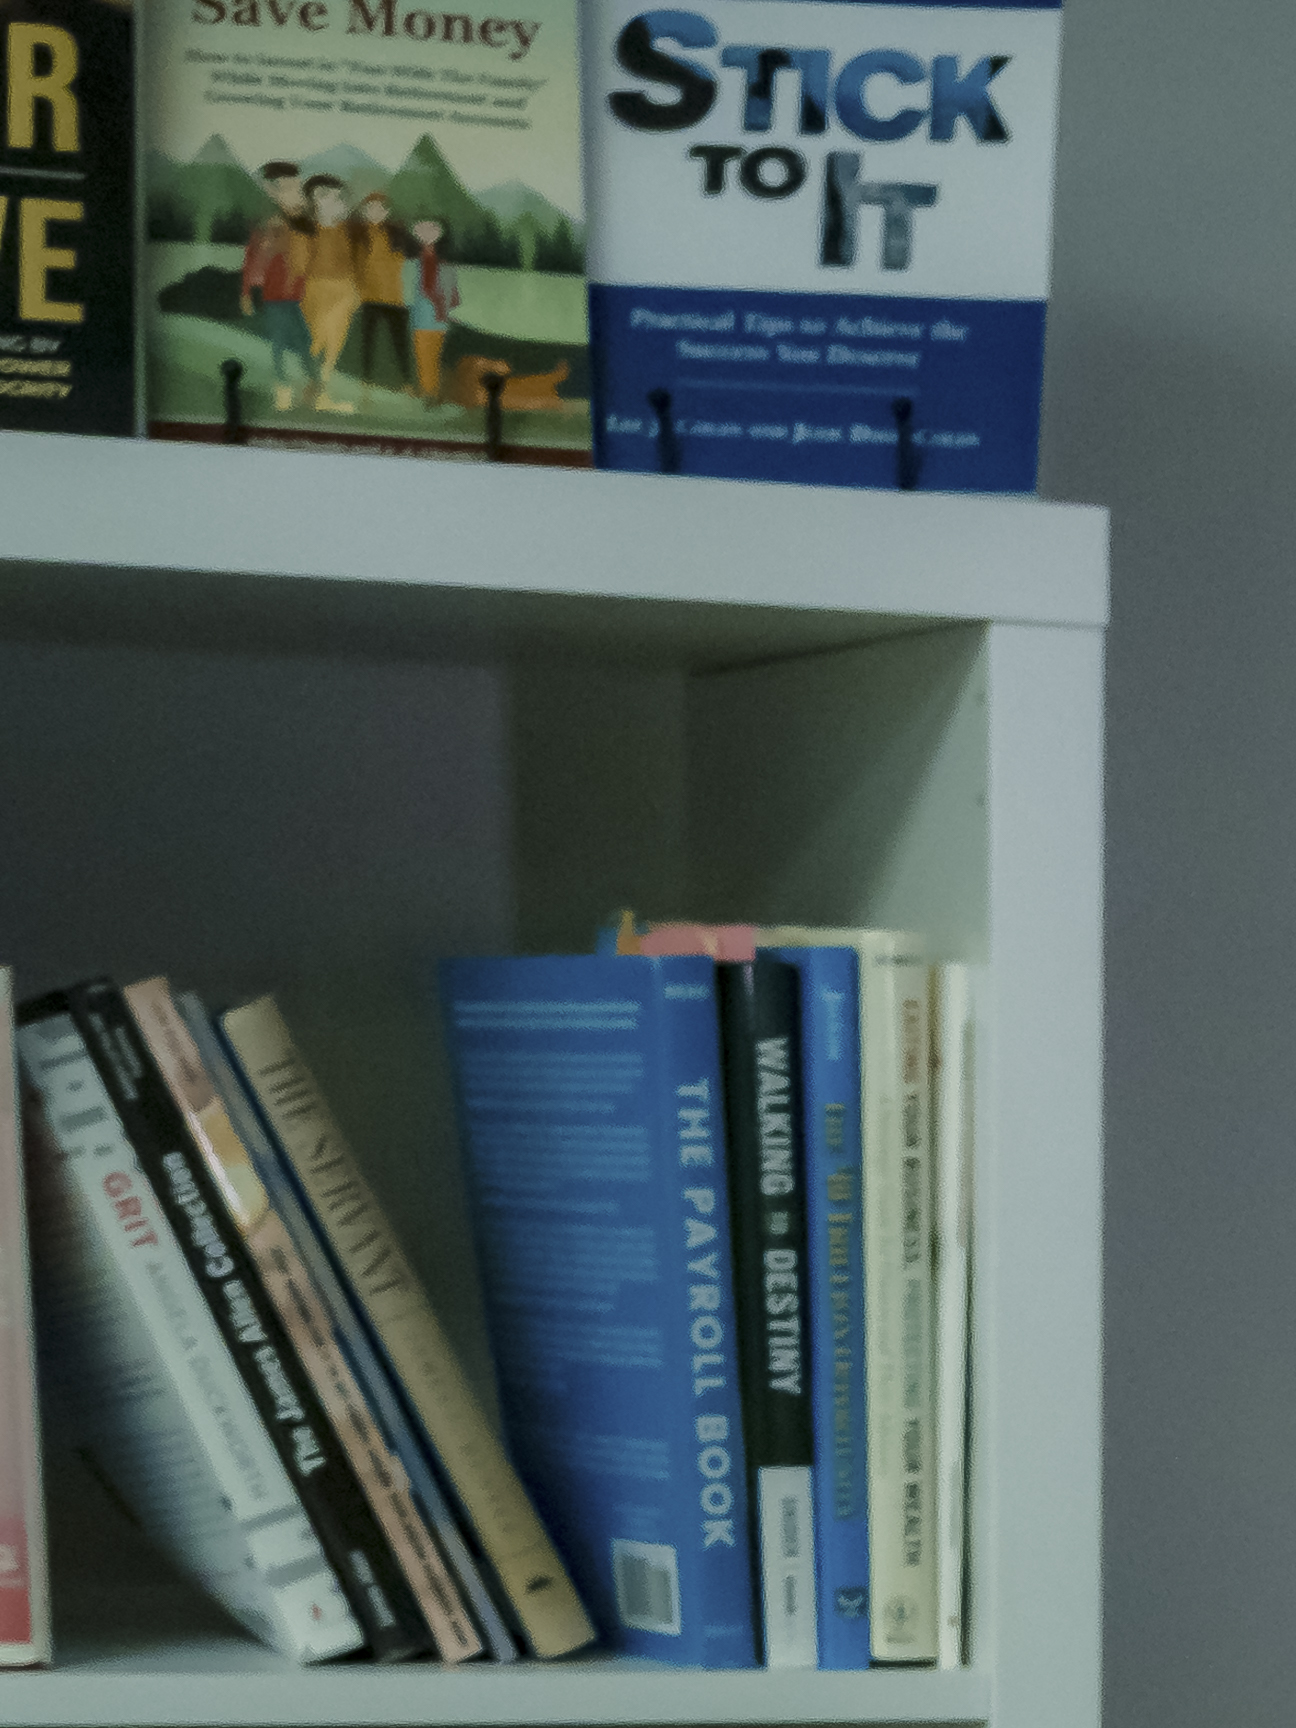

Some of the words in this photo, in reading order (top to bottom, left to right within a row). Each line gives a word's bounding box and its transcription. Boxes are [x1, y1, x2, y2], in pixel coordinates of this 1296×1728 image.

[346, 0, 543, 61] Money
[688, 144, 807, 200] TO
[819, 151, 940, 271] IT
[0, 197, 85, 324] E
[676, 1078, 715, 1169] THE
[755, 1036, 796, 1199] WALKING
[102, 1171, 158, 1249] GRIT
[161, 1150, 234, 1280] Collection
[306, 1131, 410, 1300] SERVANT
[222, 1280, 272, 1343] Allen
[683, 1186, 726, 1399] PAYROLL
[762, 1249, 801, 1397] DESTINY
[256, 1345, 306, 1424] James
[292, 1424, 326, 1475] The
[694, 1414, 738, 1550] BOOK
